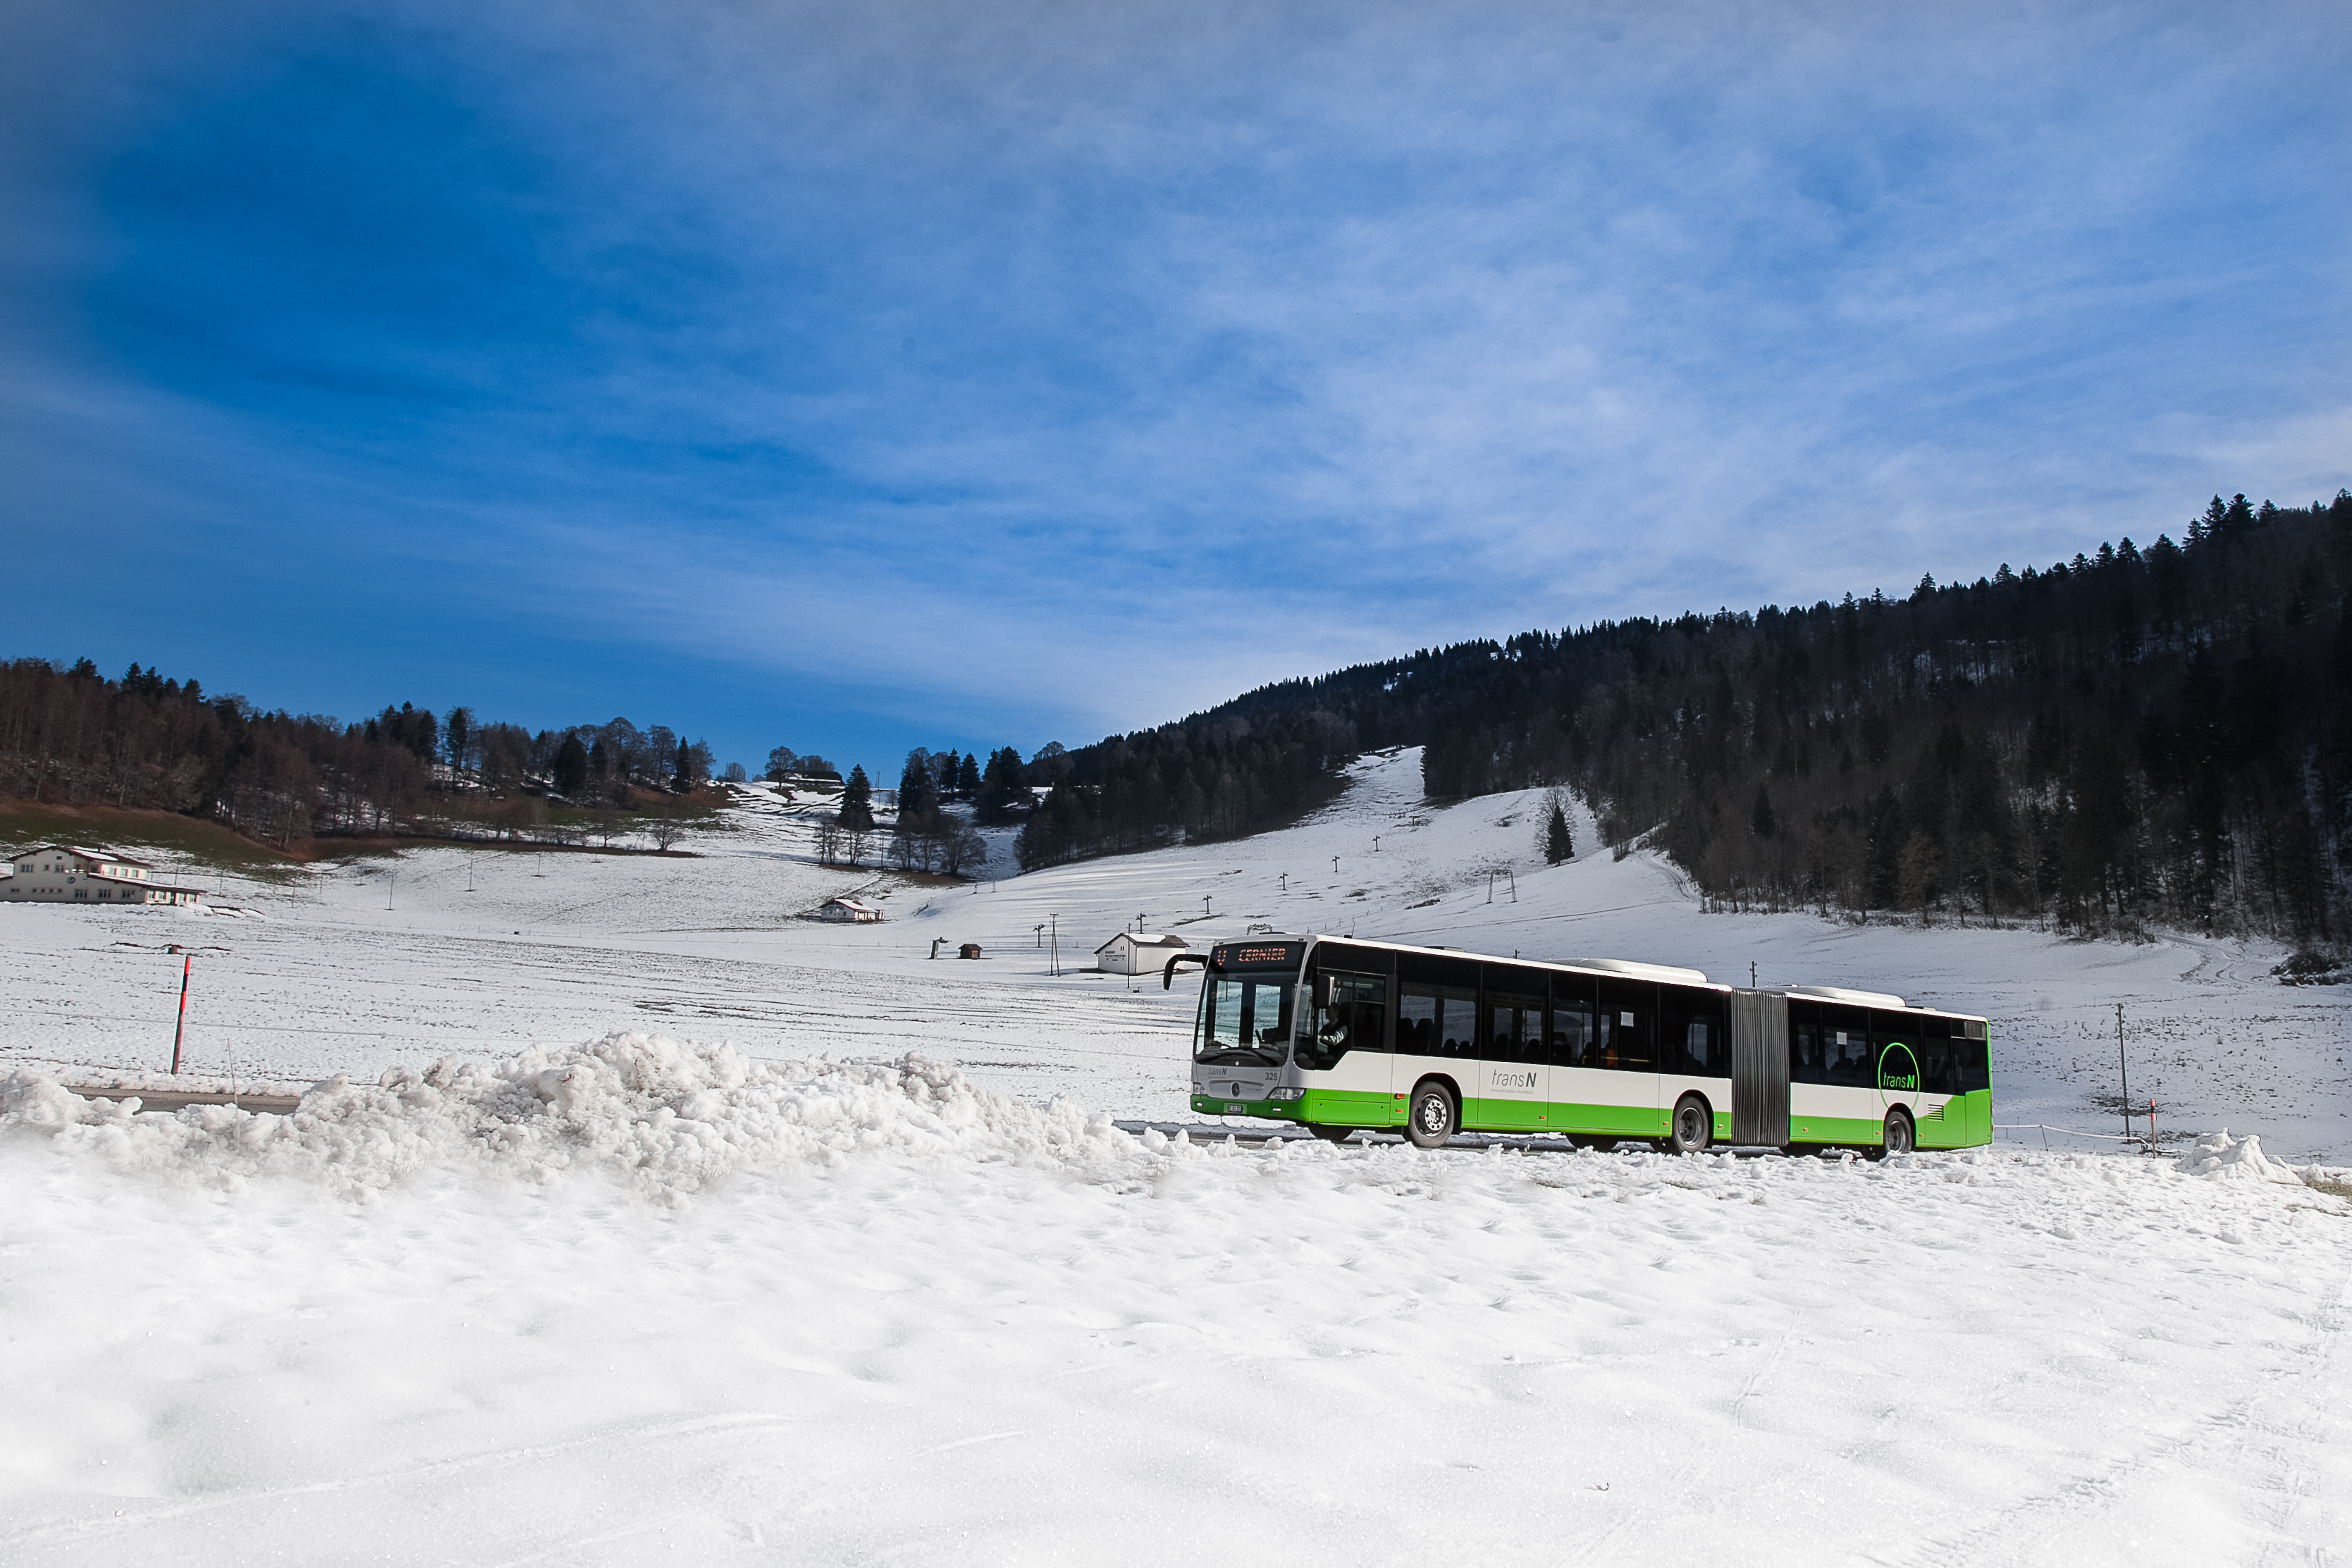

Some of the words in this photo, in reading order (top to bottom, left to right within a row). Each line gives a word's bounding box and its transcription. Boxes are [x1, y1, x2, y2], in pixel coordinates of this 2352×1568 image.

[1238, 948, 1286, 962] CERNIER
[1208, 1066, 1227, 1075] transN
[1264, 1072, 1278, 1081] 325
[1491, 1068, 1537, 1087] transN
[1883, 1072, 1915, 1089] transN
